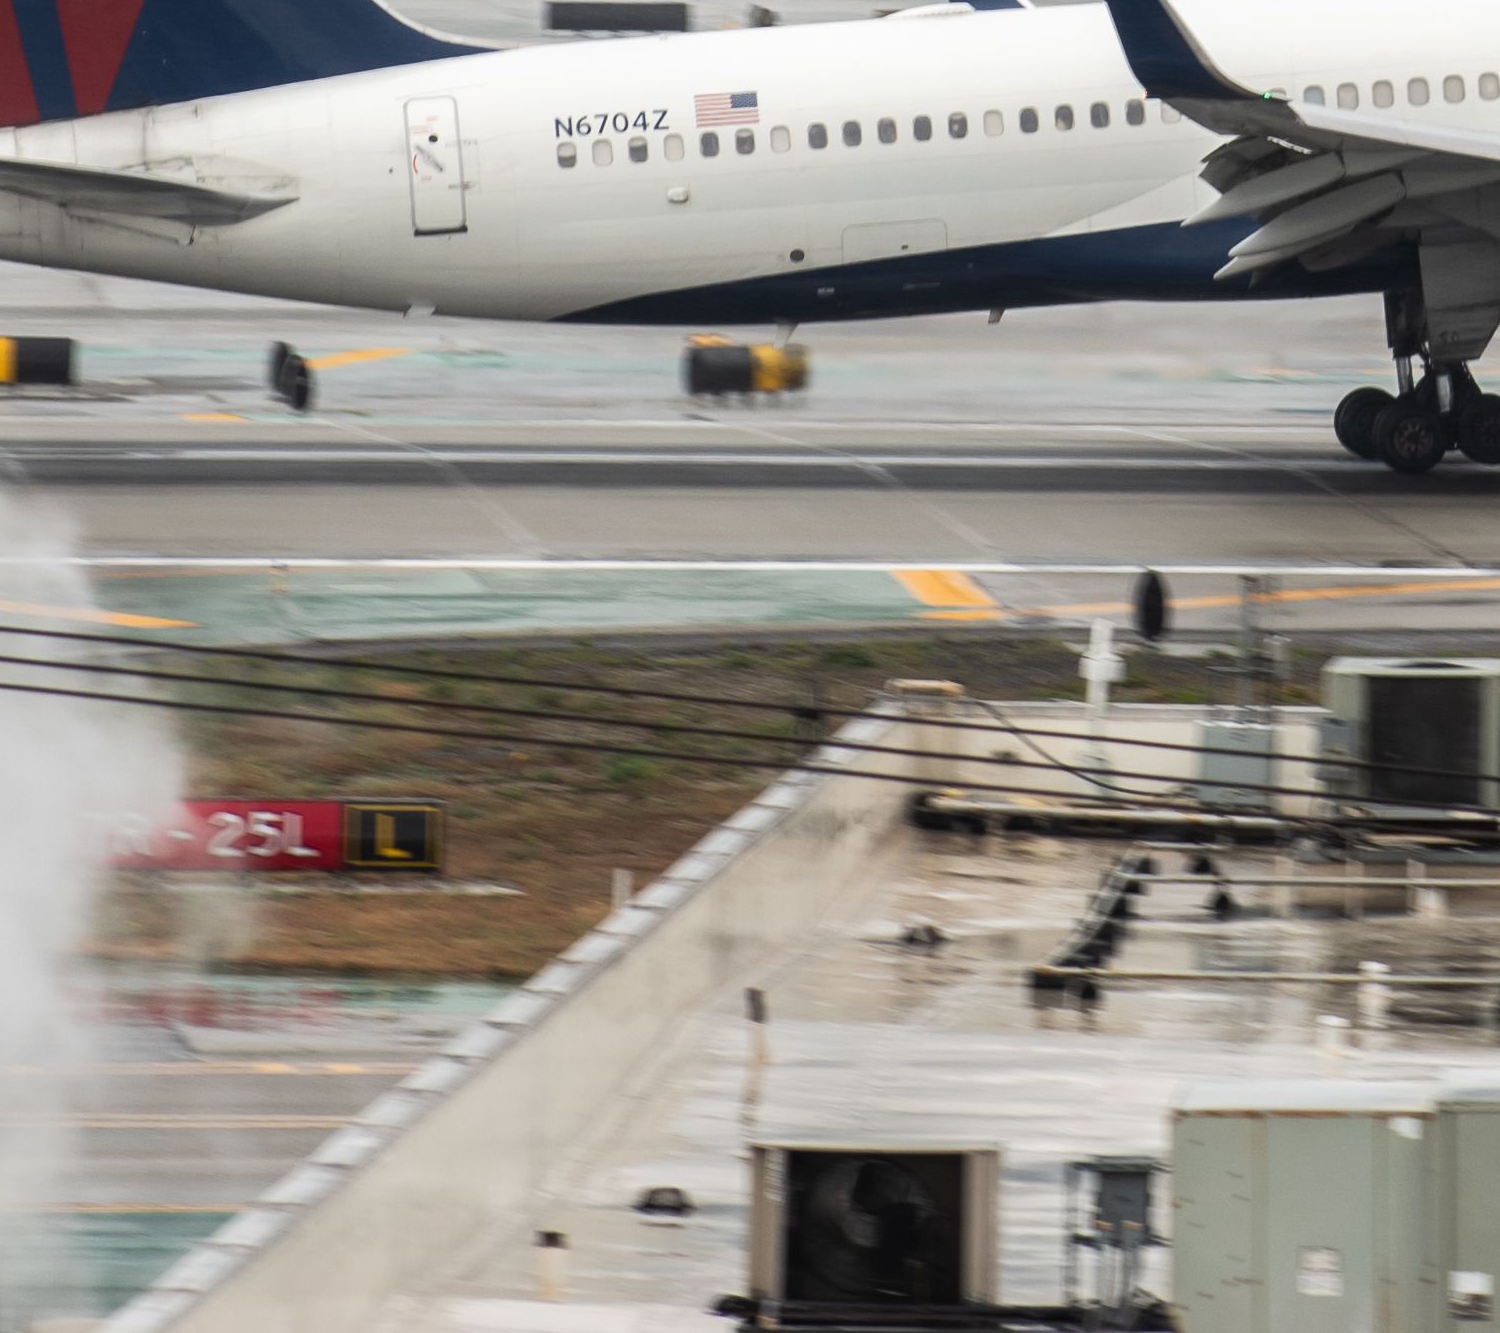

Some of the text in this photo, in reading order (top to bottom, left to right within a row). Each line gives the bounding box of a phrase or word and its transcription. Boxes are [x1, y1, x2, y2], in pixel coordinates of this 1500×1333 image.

[554, 109, 669, 137] N6704Z
[204, 811, 321, 858] 25L
[373, 812, 413, 858] L
